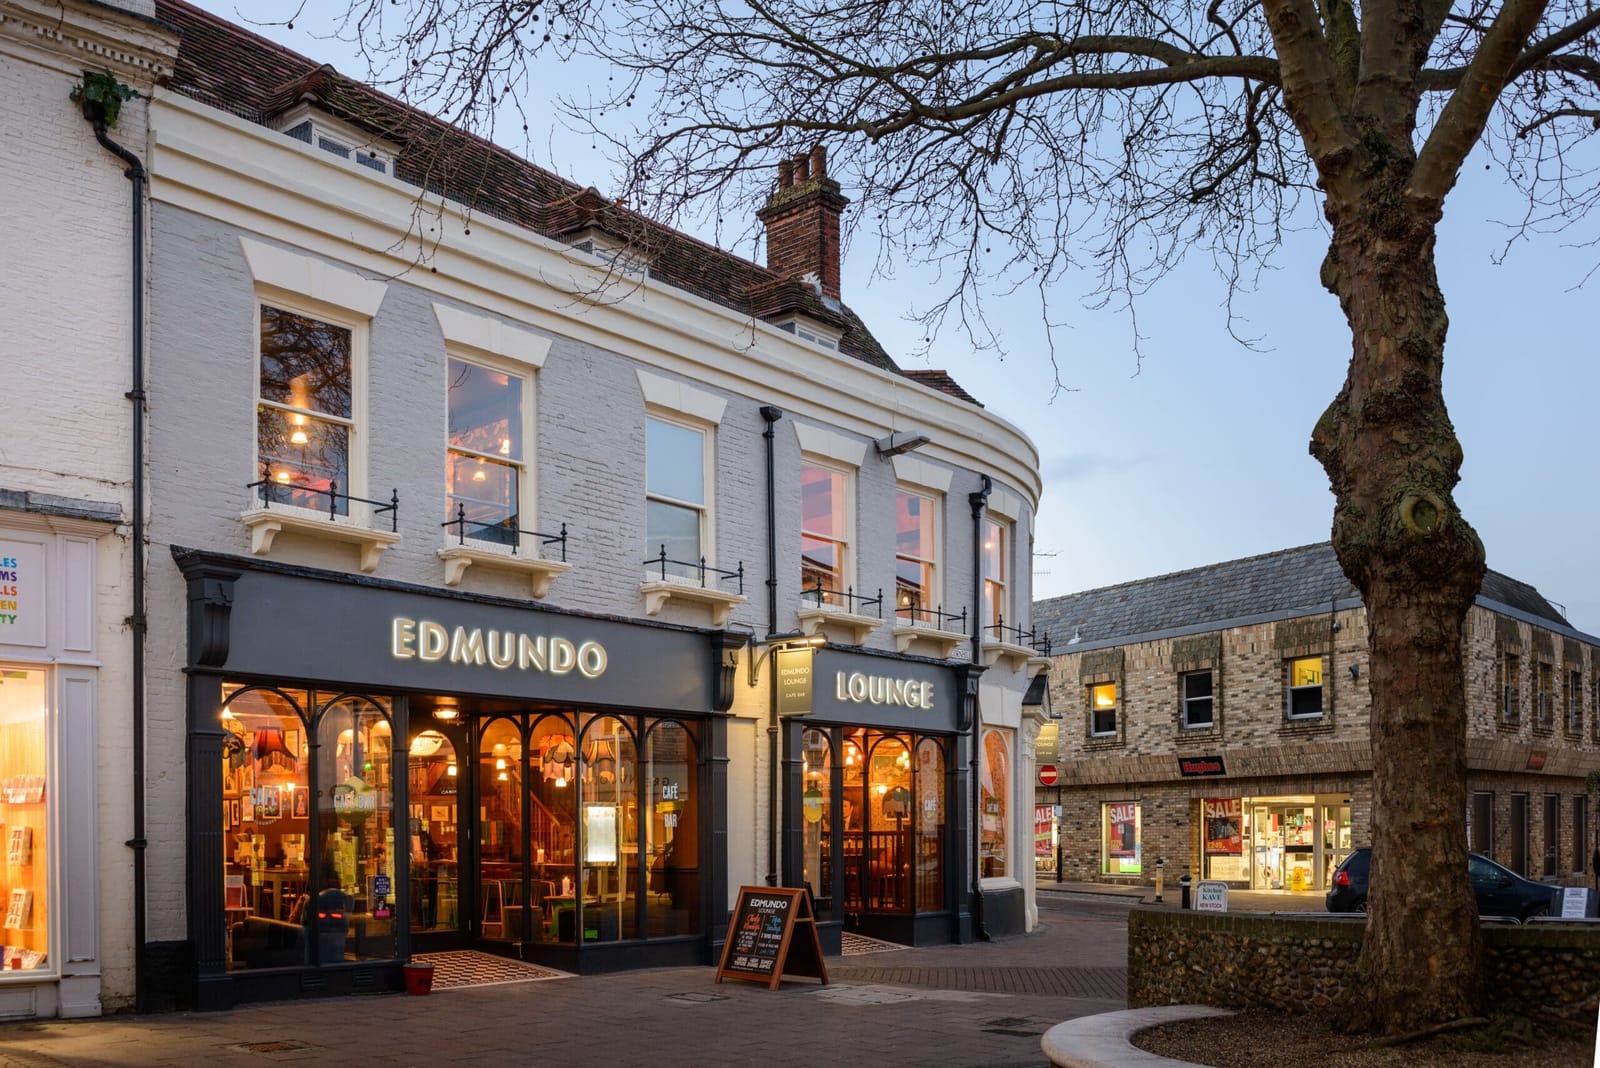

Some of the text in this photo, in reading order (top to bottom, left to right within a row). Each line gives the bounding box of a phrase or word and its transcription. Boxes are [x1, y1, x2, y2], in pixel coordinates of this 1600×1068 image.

[392, 617, 609, 679] EDMUNDO
[781, 667, 810, 676] EDMUNDO
[783, 677, 807, 686] LOUNGE
[836, 671, 935, 710] LOUNGE
[662, 783, 679, 800] CAFÉ
[358, 795, 375, 809] BAR
[1206, 800, 1240, 819] SALE
[664, 813, 678, 828] BAR
[1110, 805, 1135, 824] SALE
[750, 898, 788, 909] EDMUNDO
